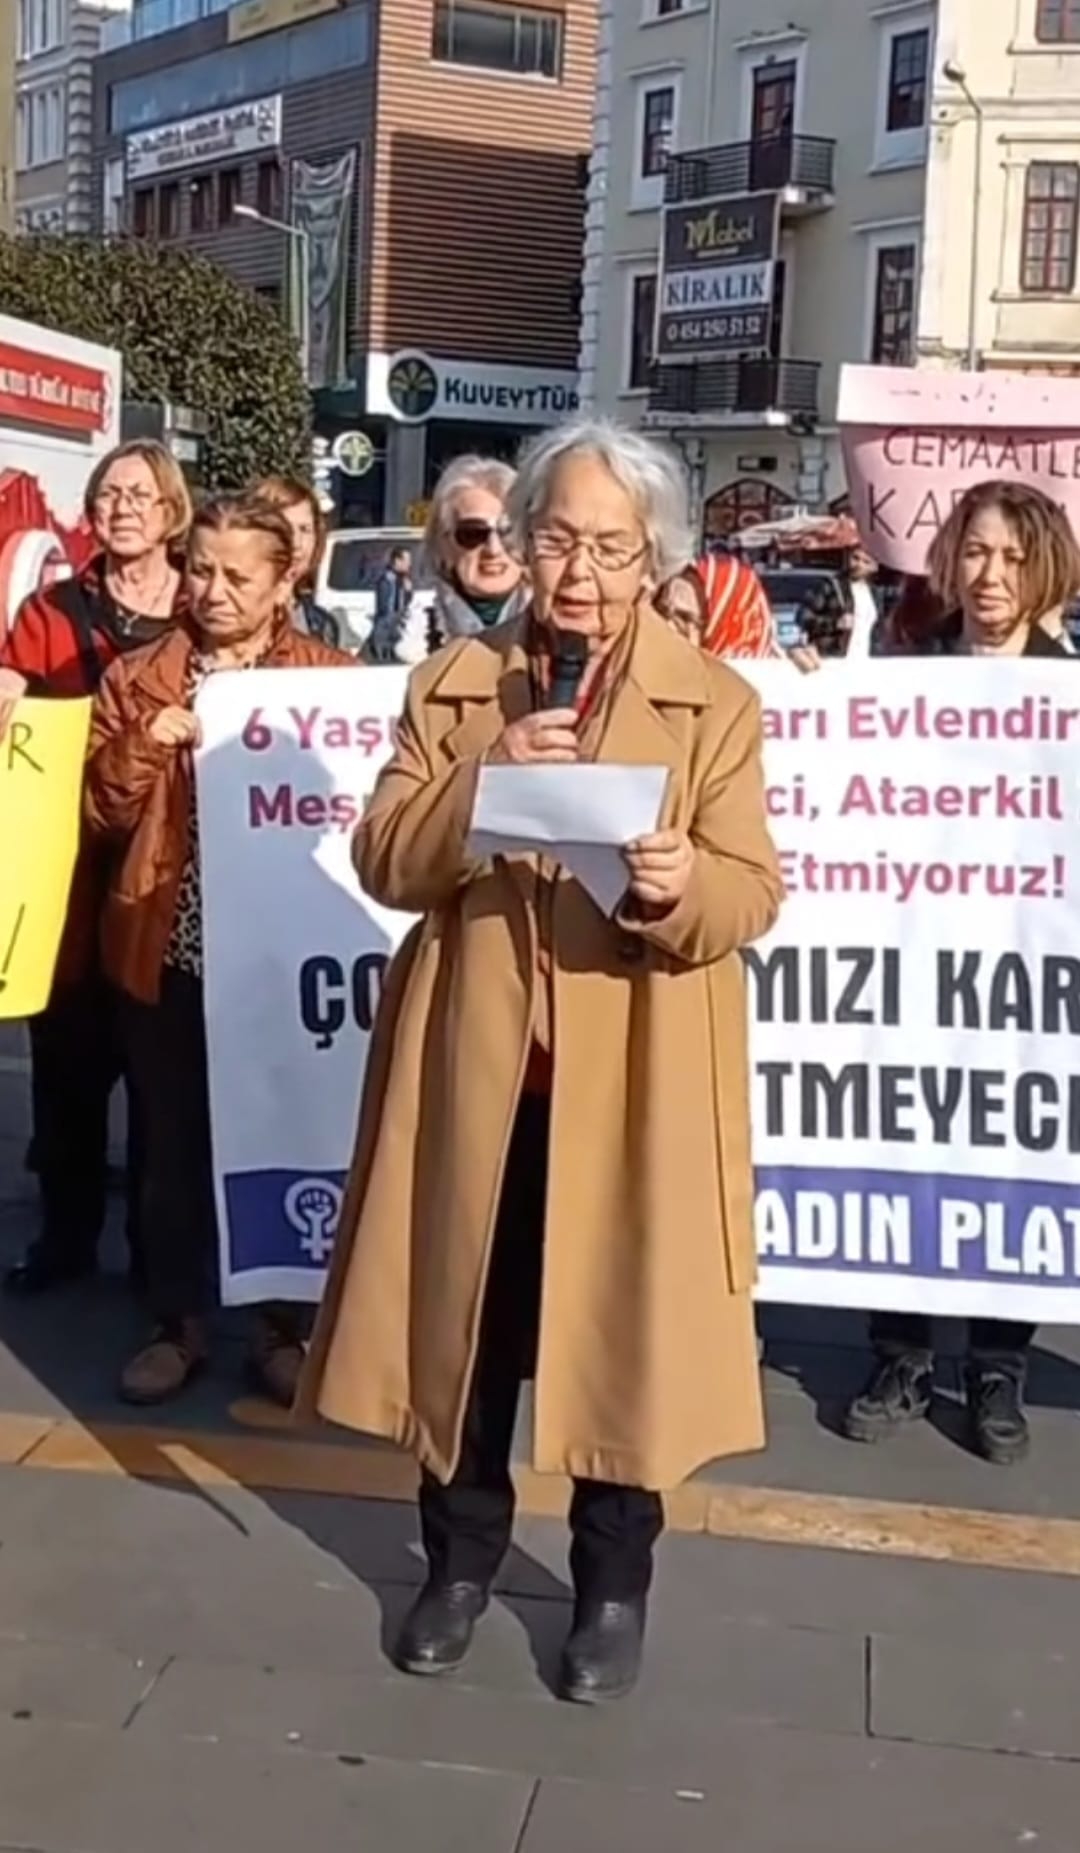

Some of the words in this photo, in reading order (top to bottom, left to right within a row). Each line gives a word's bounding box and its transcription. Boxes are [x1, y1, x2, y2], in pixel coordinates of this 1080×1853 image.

[667, 271, 765, 305] KİRALIK
[241, 707, 272, 751] 6
[848, 696, 1080, 740] Evlendir
[838, 774, 1063, 820] Ataerkil
[777, 850, 1065, 902] Etmiyoruz!
[937, 949, 1080, 1034] KAR
[756, 1061, 1080, 1153] TMEYEC
[754, 1189, 911, 1264] ADIN
